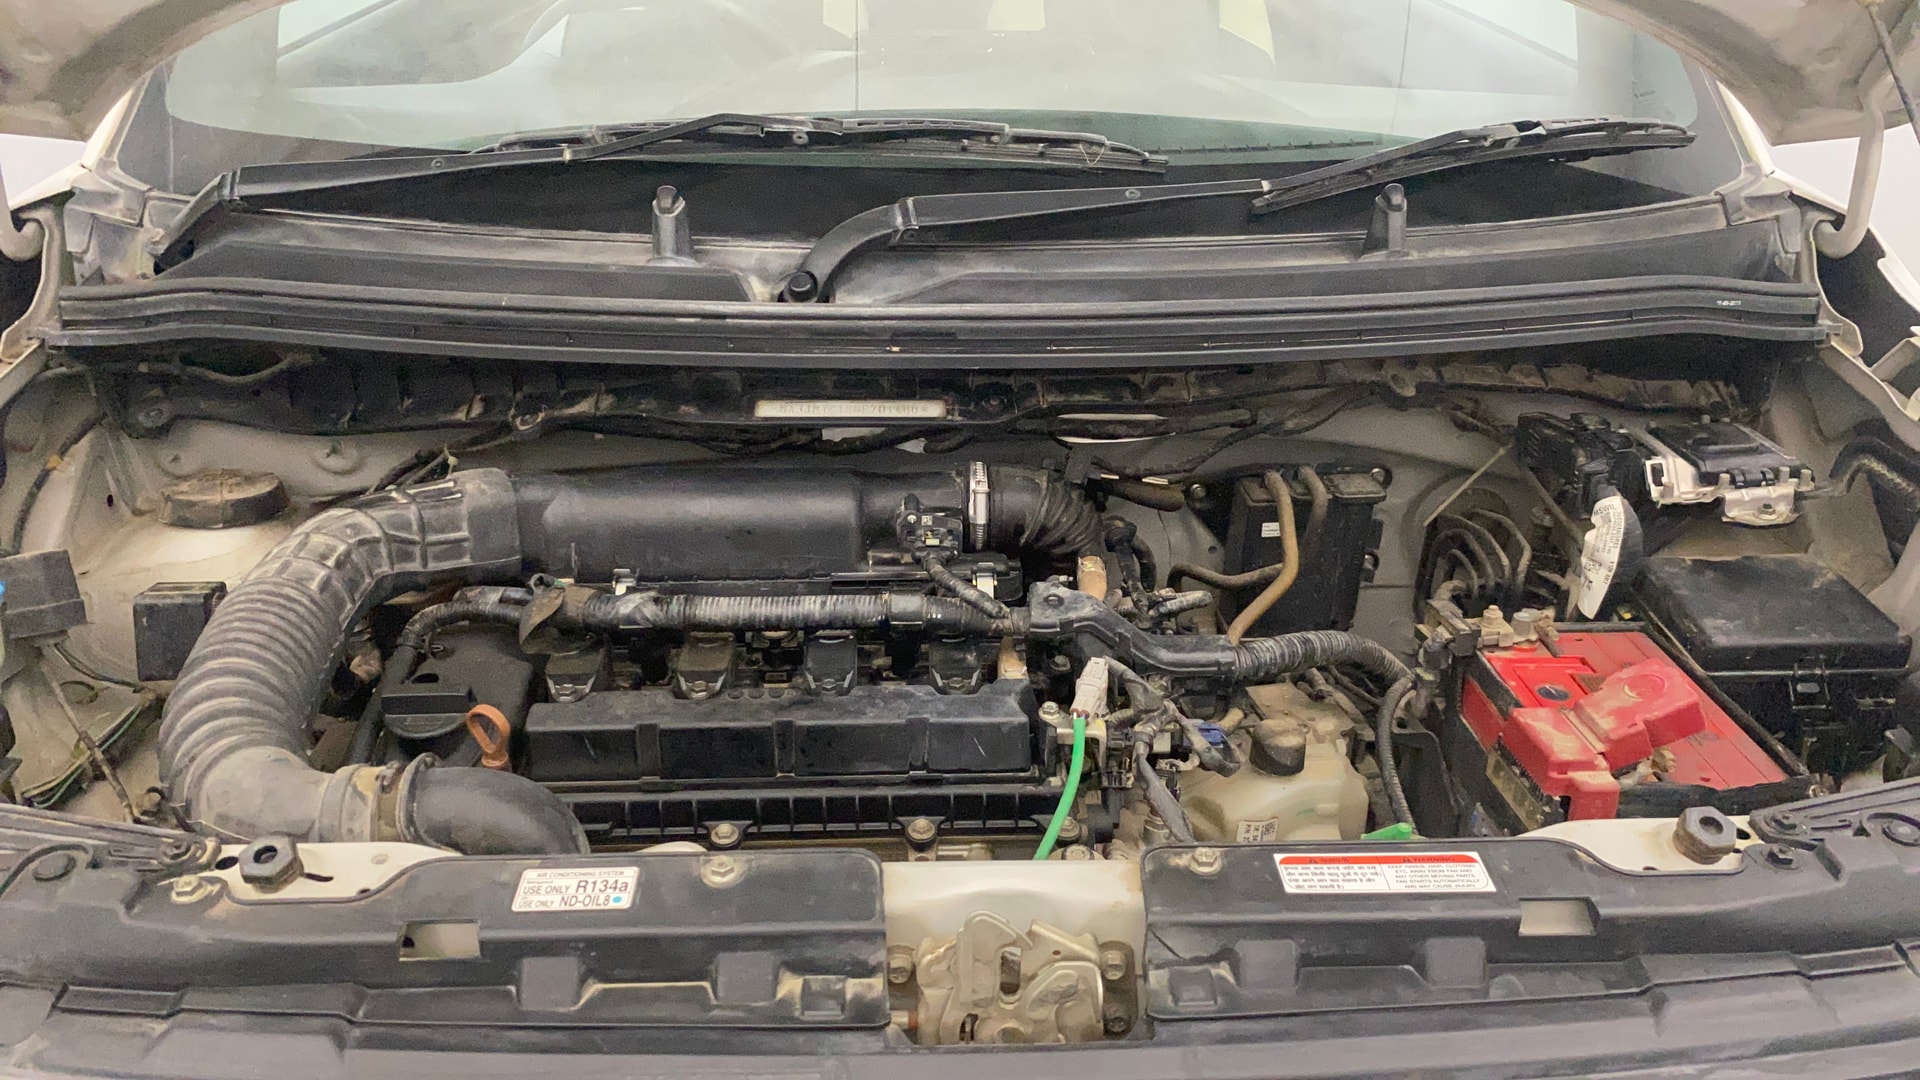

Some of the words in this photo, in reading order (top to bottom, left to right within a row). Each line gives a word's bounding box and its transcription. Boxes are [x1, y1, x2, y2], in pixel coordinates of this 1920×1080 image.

[1594, 504, 1617, 517] MSWIL
[522, 885, 543, 895] USE
[545, 885, 571, 894] ONLY
[575, 879, 629, 894] R134a
[518, 900, 534, 908] USE
[535, 900, 555, 908] ONLY
[560, 894, 612, 907] ND-OIL8
